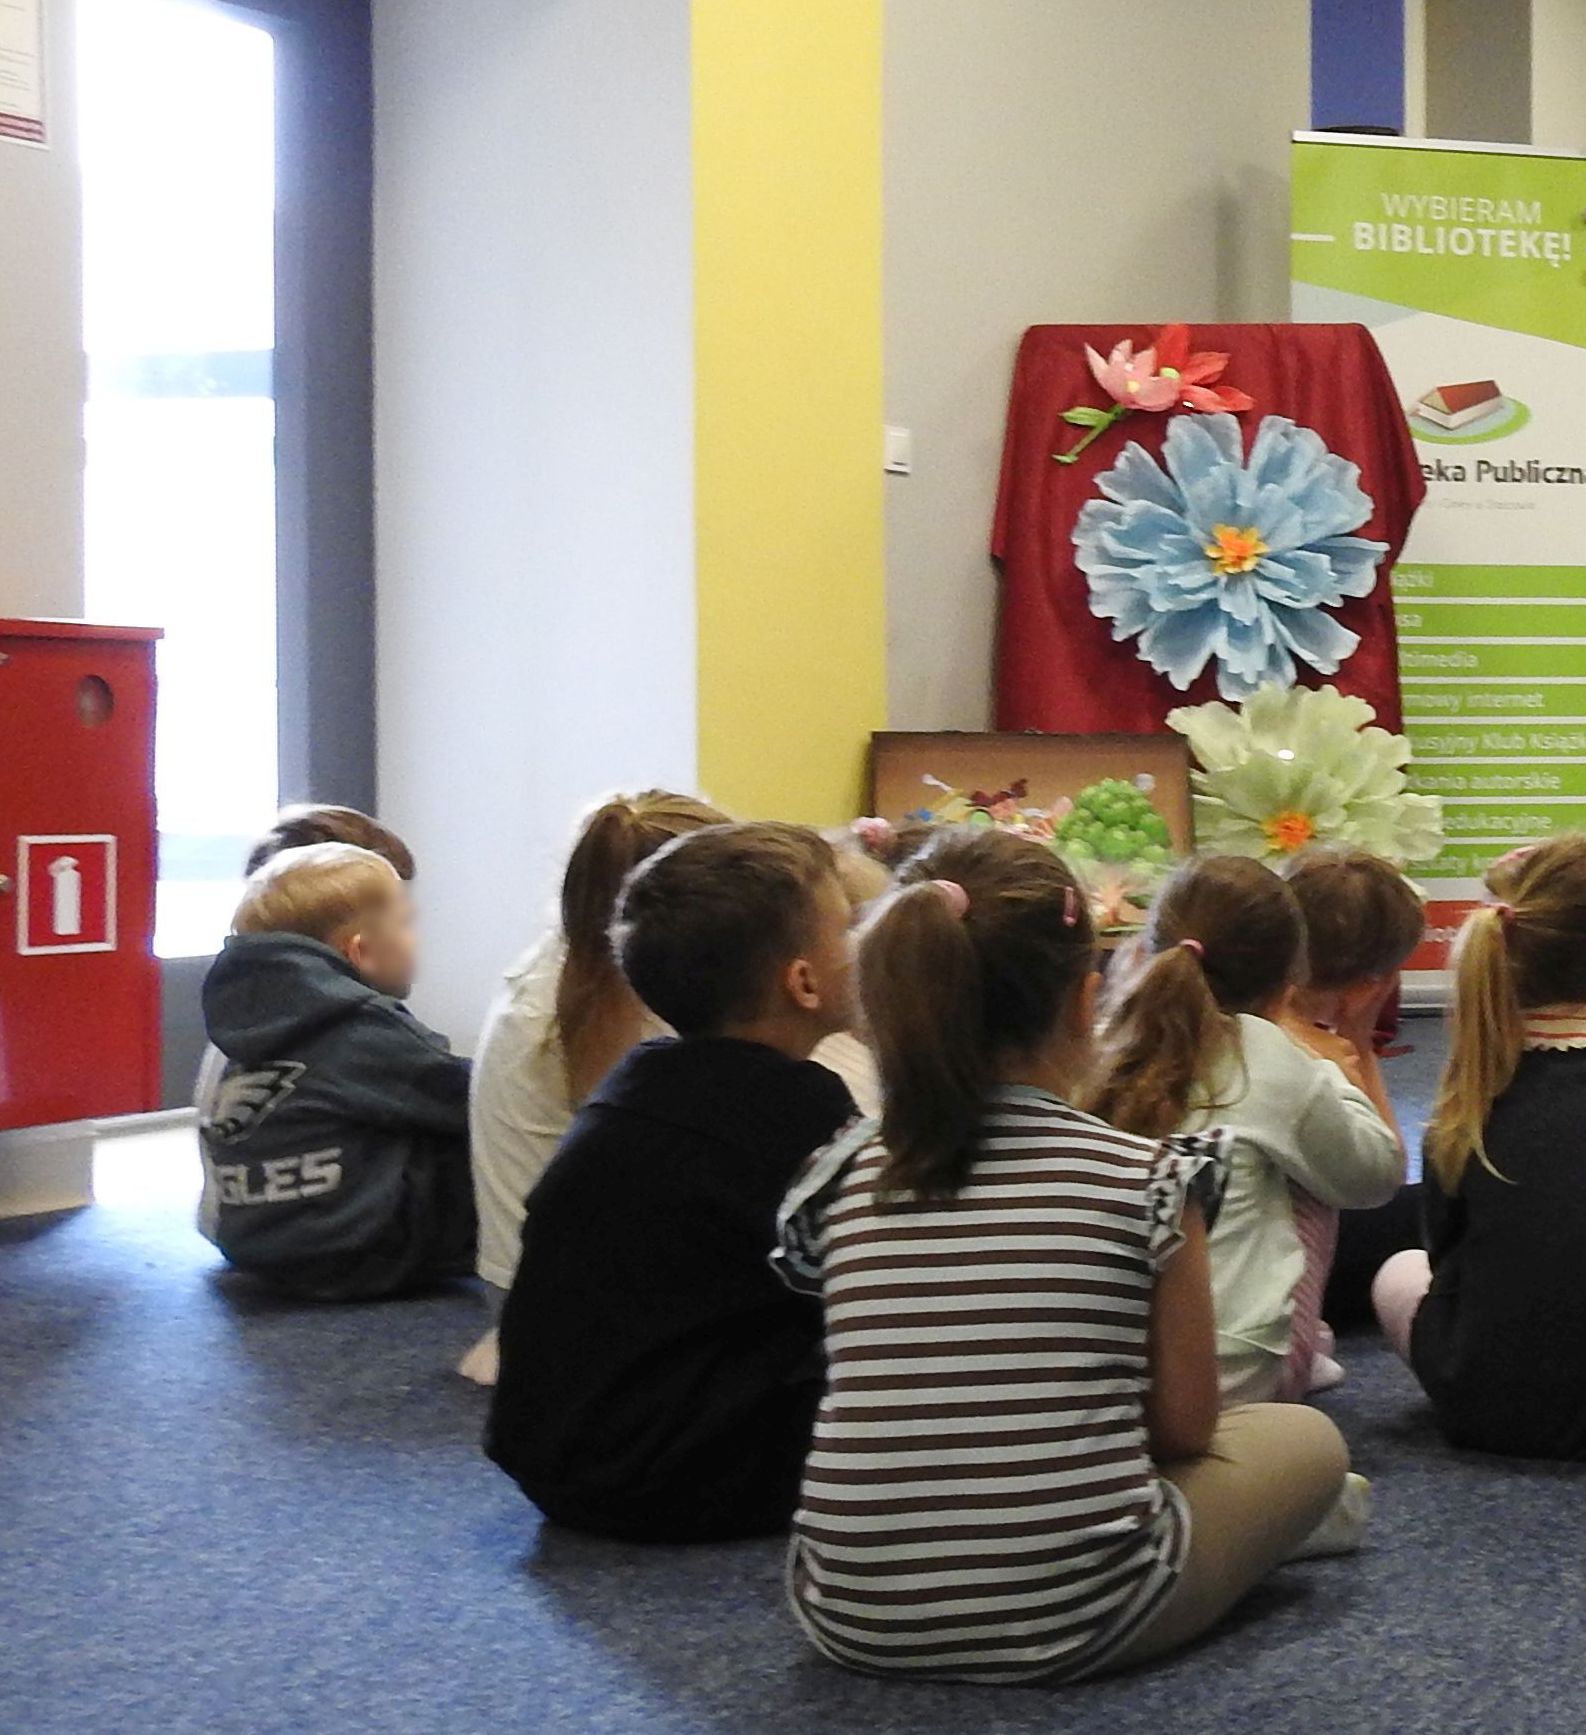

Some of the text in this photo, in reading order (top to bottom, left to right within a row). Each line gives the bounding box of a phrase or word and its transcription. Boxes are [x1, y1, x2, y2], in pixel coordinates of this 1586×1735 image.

[1381, 193, 1541, 225] WYBIERAM
[1353, 221, 1571, 268] BIBLIOTEKĘ!
[1466, 692, 1545, 708] internet
[1481, 733, 1526, 750] Klub
[1470, 772, 1562, 790] autorskie
